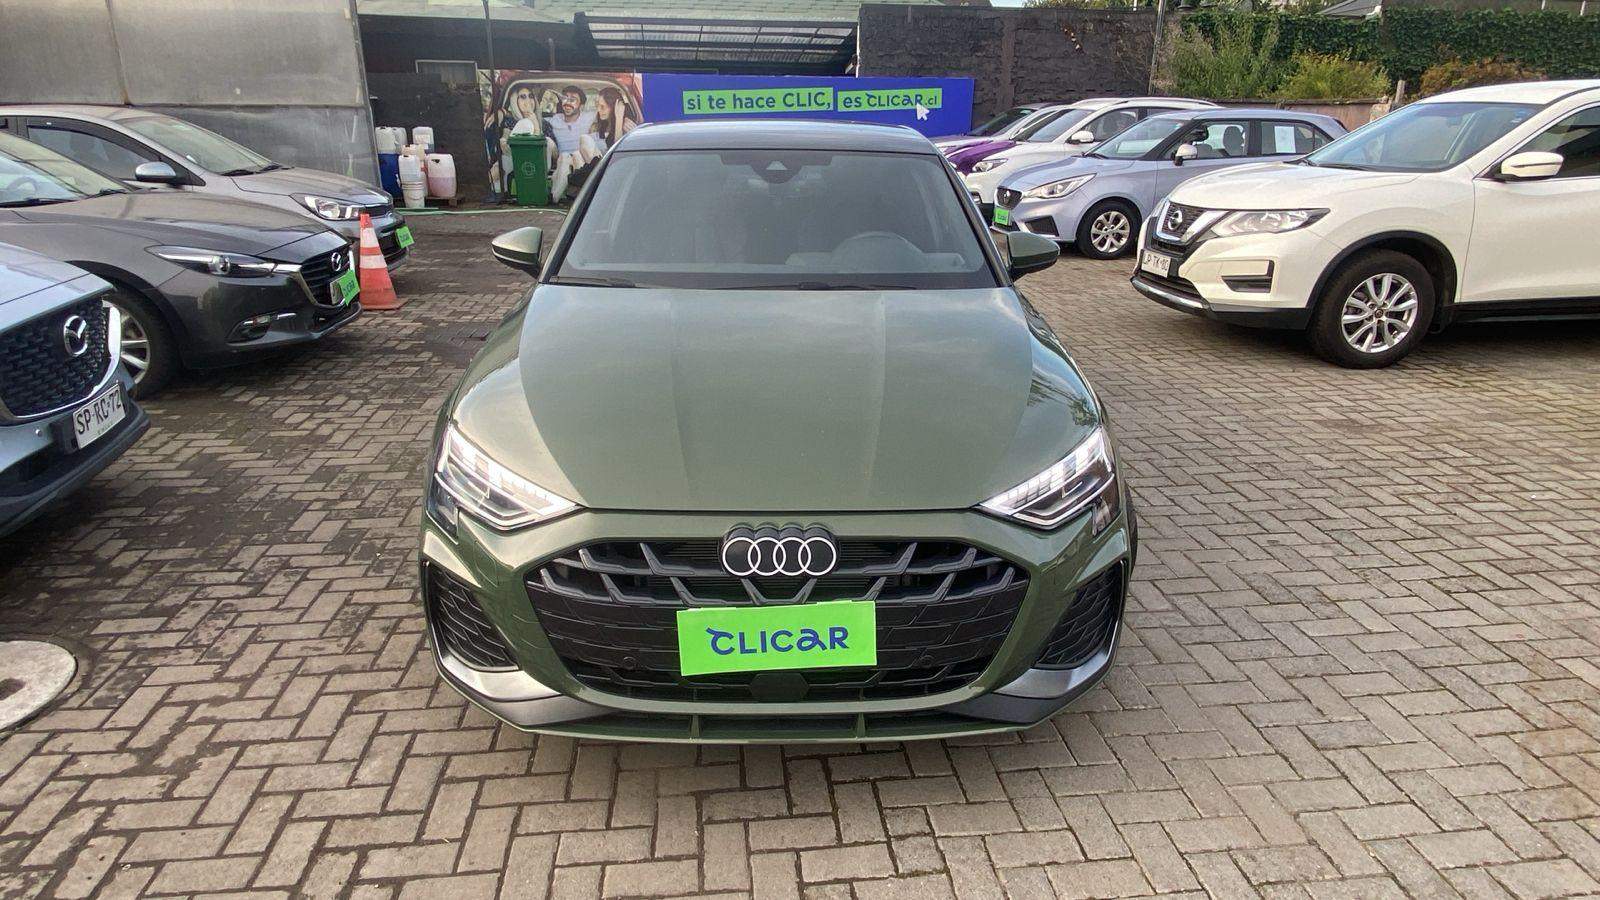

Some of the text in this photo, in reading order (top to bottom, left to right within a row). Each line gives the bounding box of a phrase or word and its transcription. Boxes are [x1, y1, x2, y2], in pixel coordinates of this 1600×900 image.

[687, 93, 701, 110] si
[708, 93, 726, 110] te
[732, 93, 776, 110] hace
[782, 91, 831, 110] CLIC,
[843, 96, 862, 108] es
